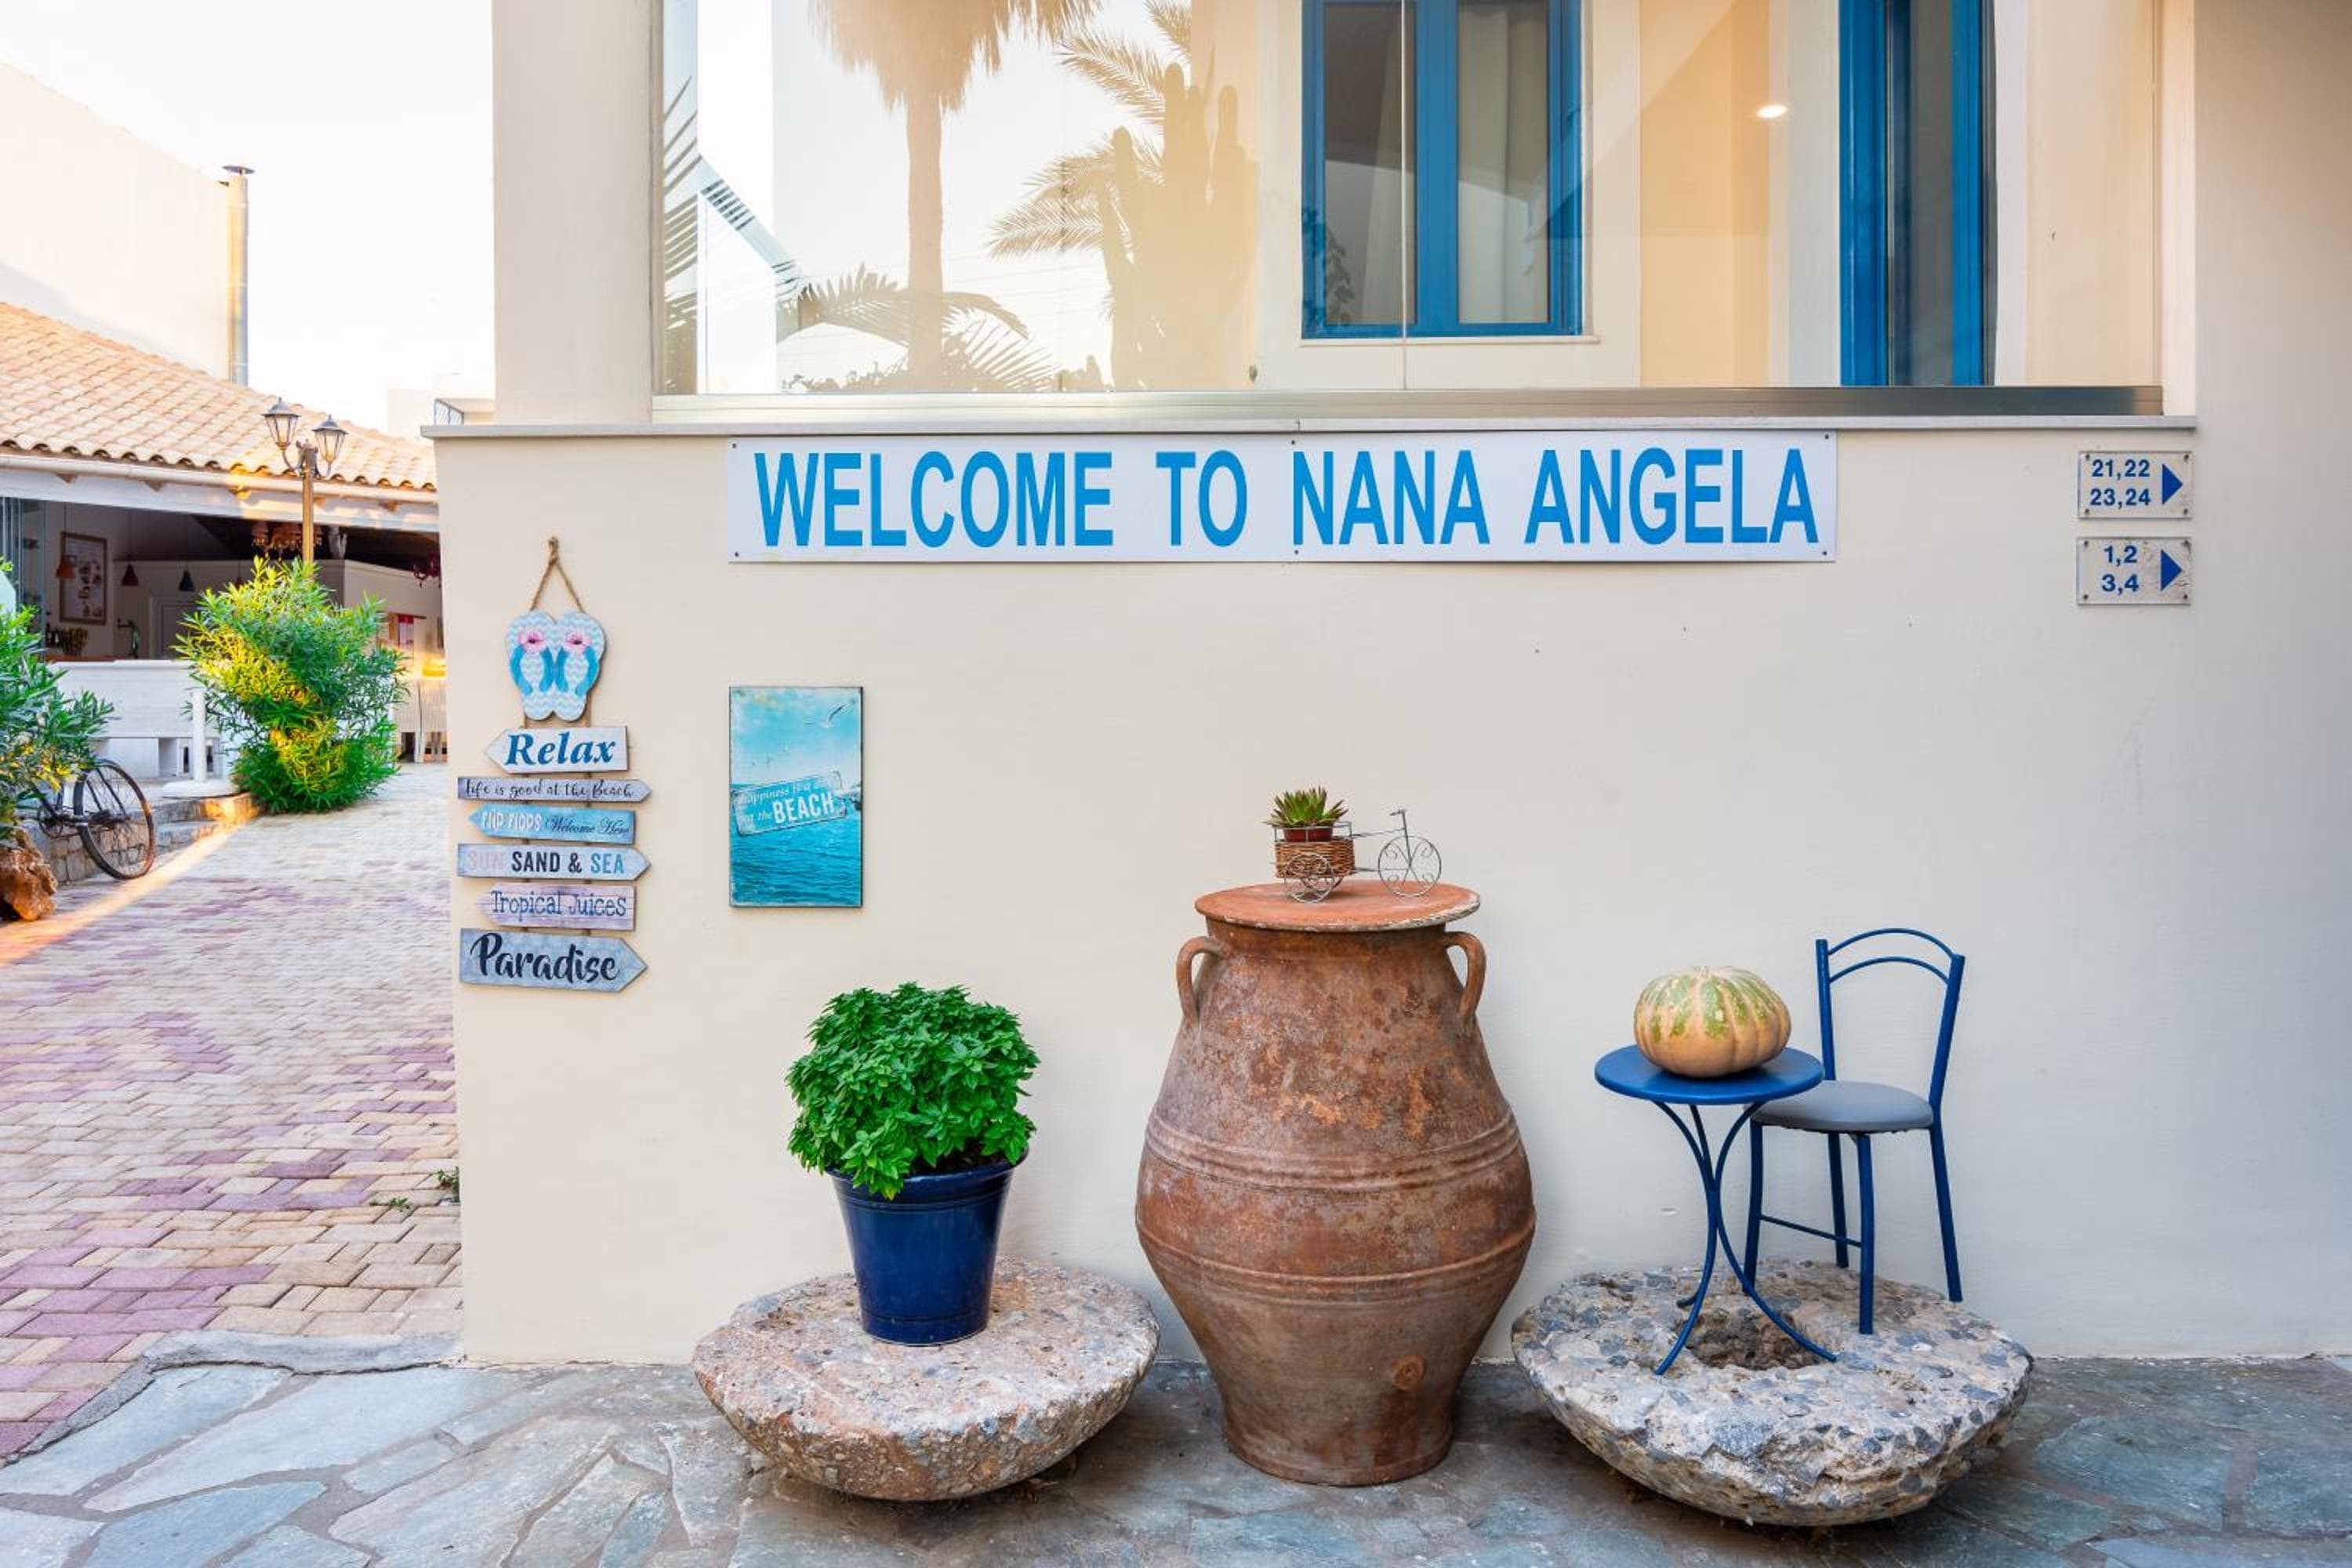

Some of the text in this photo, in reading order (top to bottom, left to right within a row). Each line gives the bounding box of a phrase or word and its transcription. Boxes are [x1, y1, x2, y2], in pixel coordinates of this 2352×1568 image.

[2092, 459, 2150, 481] 21,22
[754, 447, 1819, 547] WELCOME TO NANA ANGELA
[2090, 488, 2151, 509] 23,24
[2104, 545, 2137, 567] 1,2
[2102, 574, 2139, 596] 3,4
[505, 731, 615, 765] Relax
[495, 786, 504, 795] is
[510, 779, 542, 798] good
[772, 792, 834, 824] BEACH
[511, 851, 561, 873] SAND
[568, 852, 582, 873] &
[590, 852, 625, 873] SEA
[491, 890, 627, 923] Tropical Juices
[470, 933, 620, 984] Paradise
